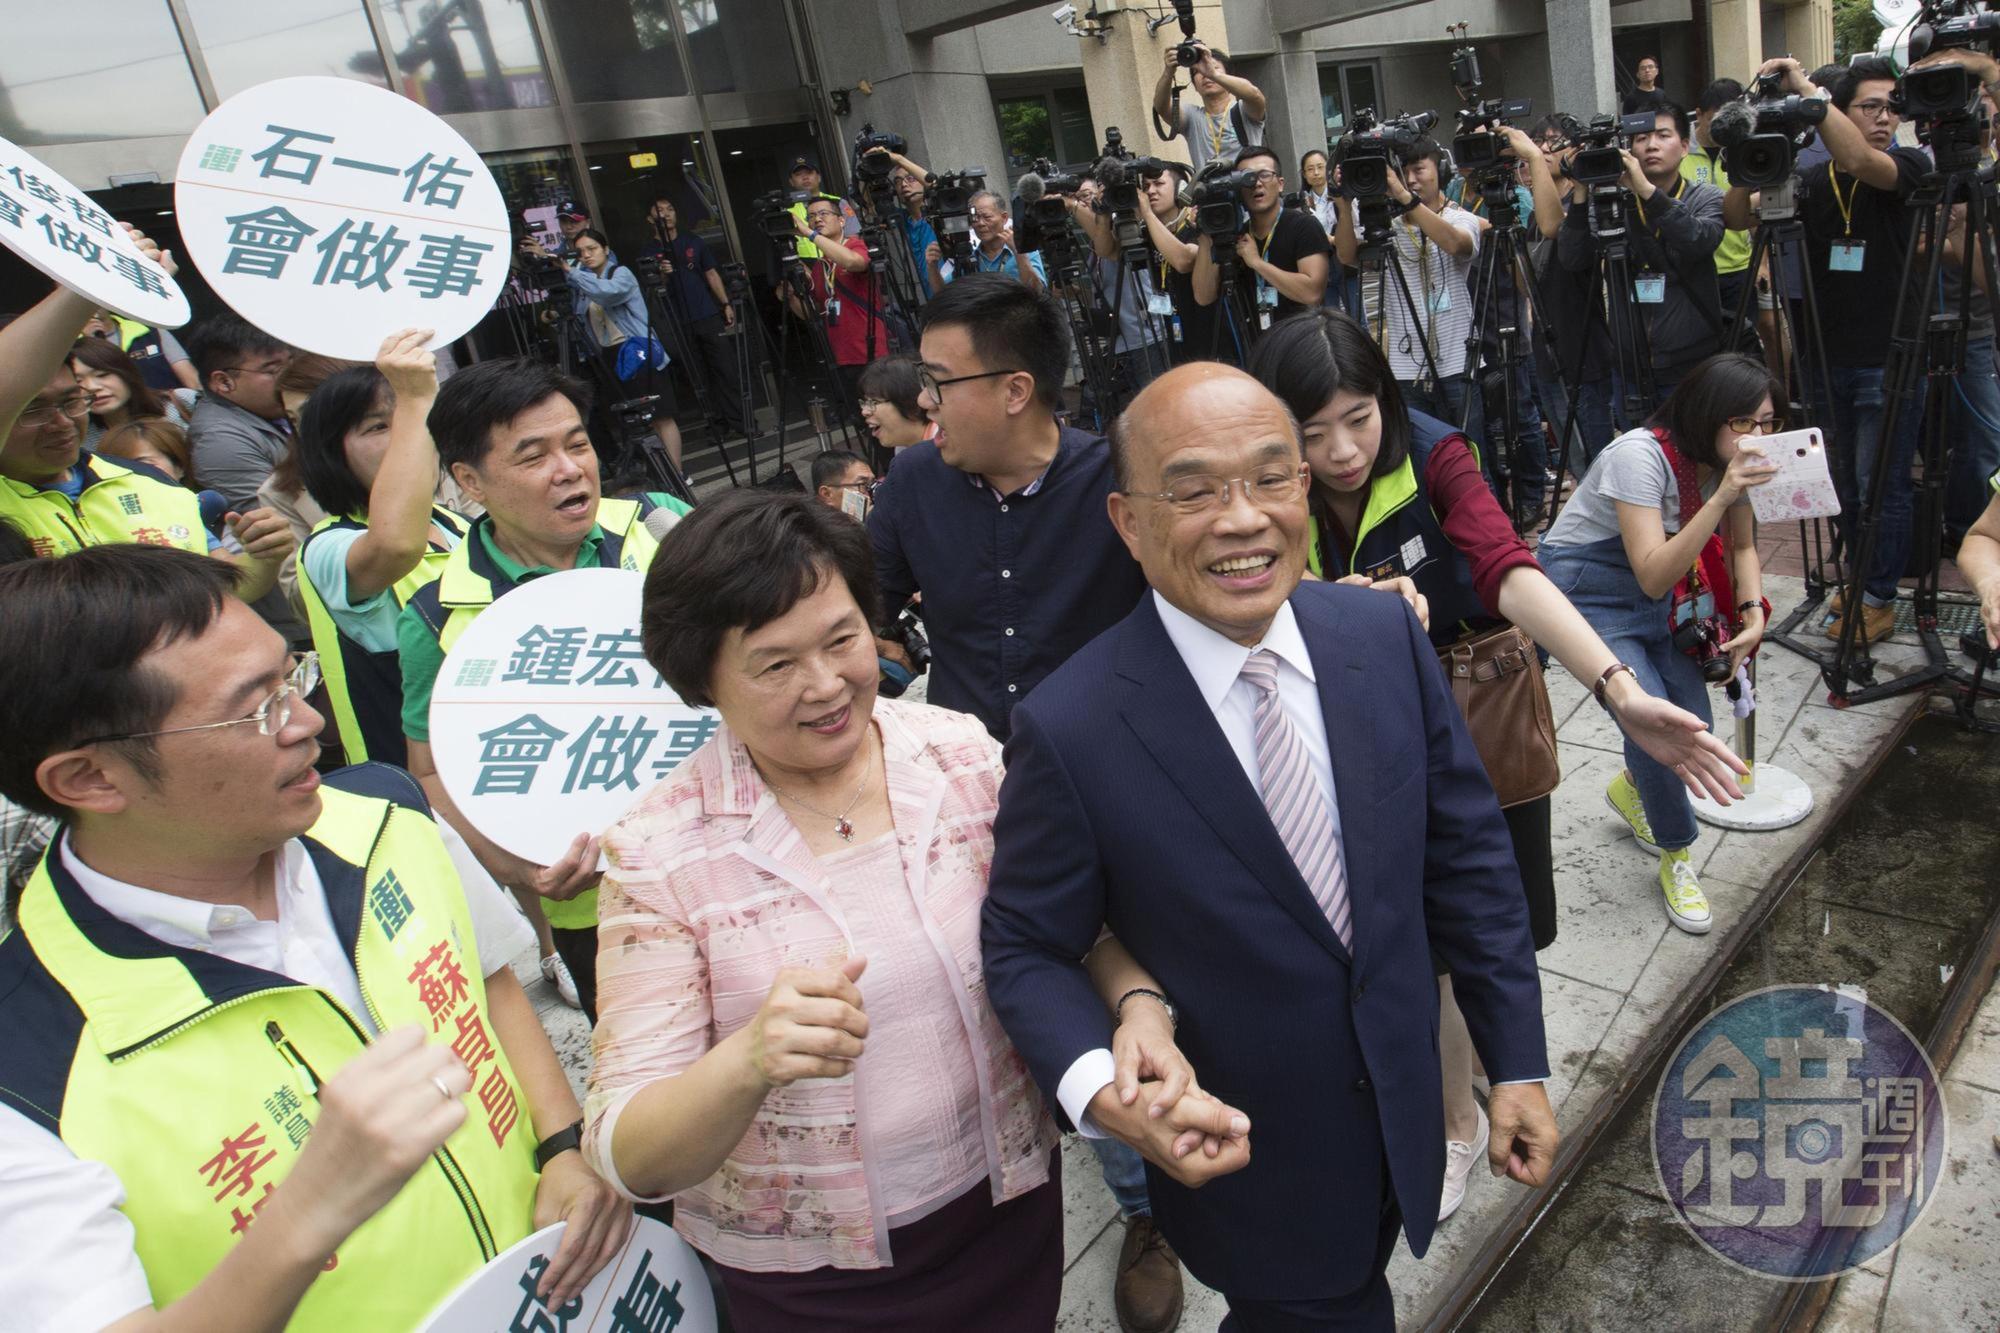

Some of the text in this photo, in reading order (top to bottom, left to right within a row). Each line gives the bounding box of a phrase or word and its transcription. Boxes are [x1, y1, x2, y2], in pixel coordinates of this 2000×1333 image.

[0, 163, 114, 239] 俊哲
[251, 124, 473, 209] 石一佑
[222, 205, 494, 299] 會做事
[501, 624, 668, 688] 鍾宏
[407, 939, 519, 1150] 蘇貞昌
[264, 1085, 314, 1151] 議員
